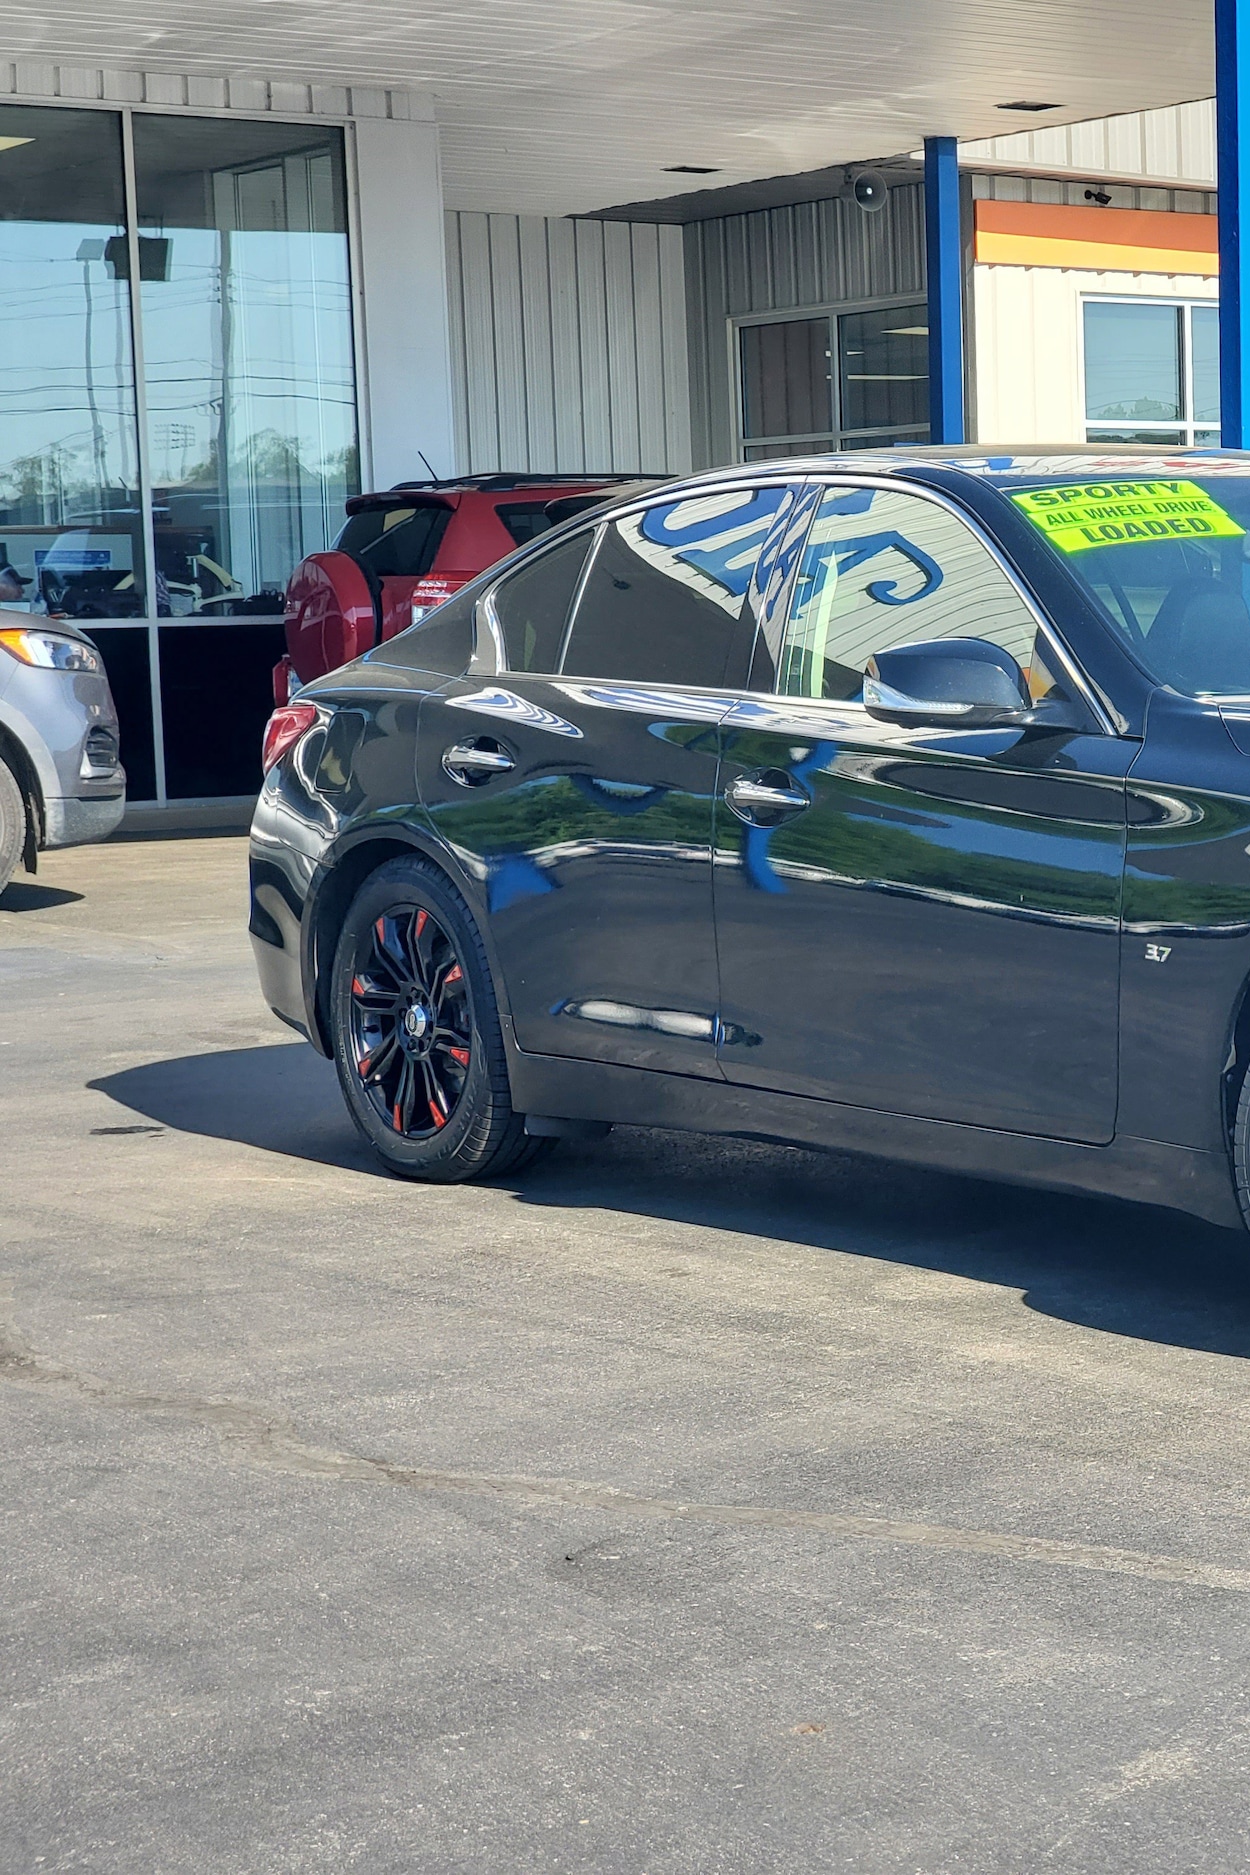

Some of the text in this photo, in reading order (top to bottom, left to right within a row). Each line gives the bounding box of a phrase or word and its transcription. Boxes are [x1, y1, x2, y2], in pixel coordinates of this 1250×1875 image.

[1029, 483, 1181, 506] SPORTY
[1047, 500, 1212, 526] ALL WHEEL DRIVE
[1080, 517, 1214, 543] LOADED
